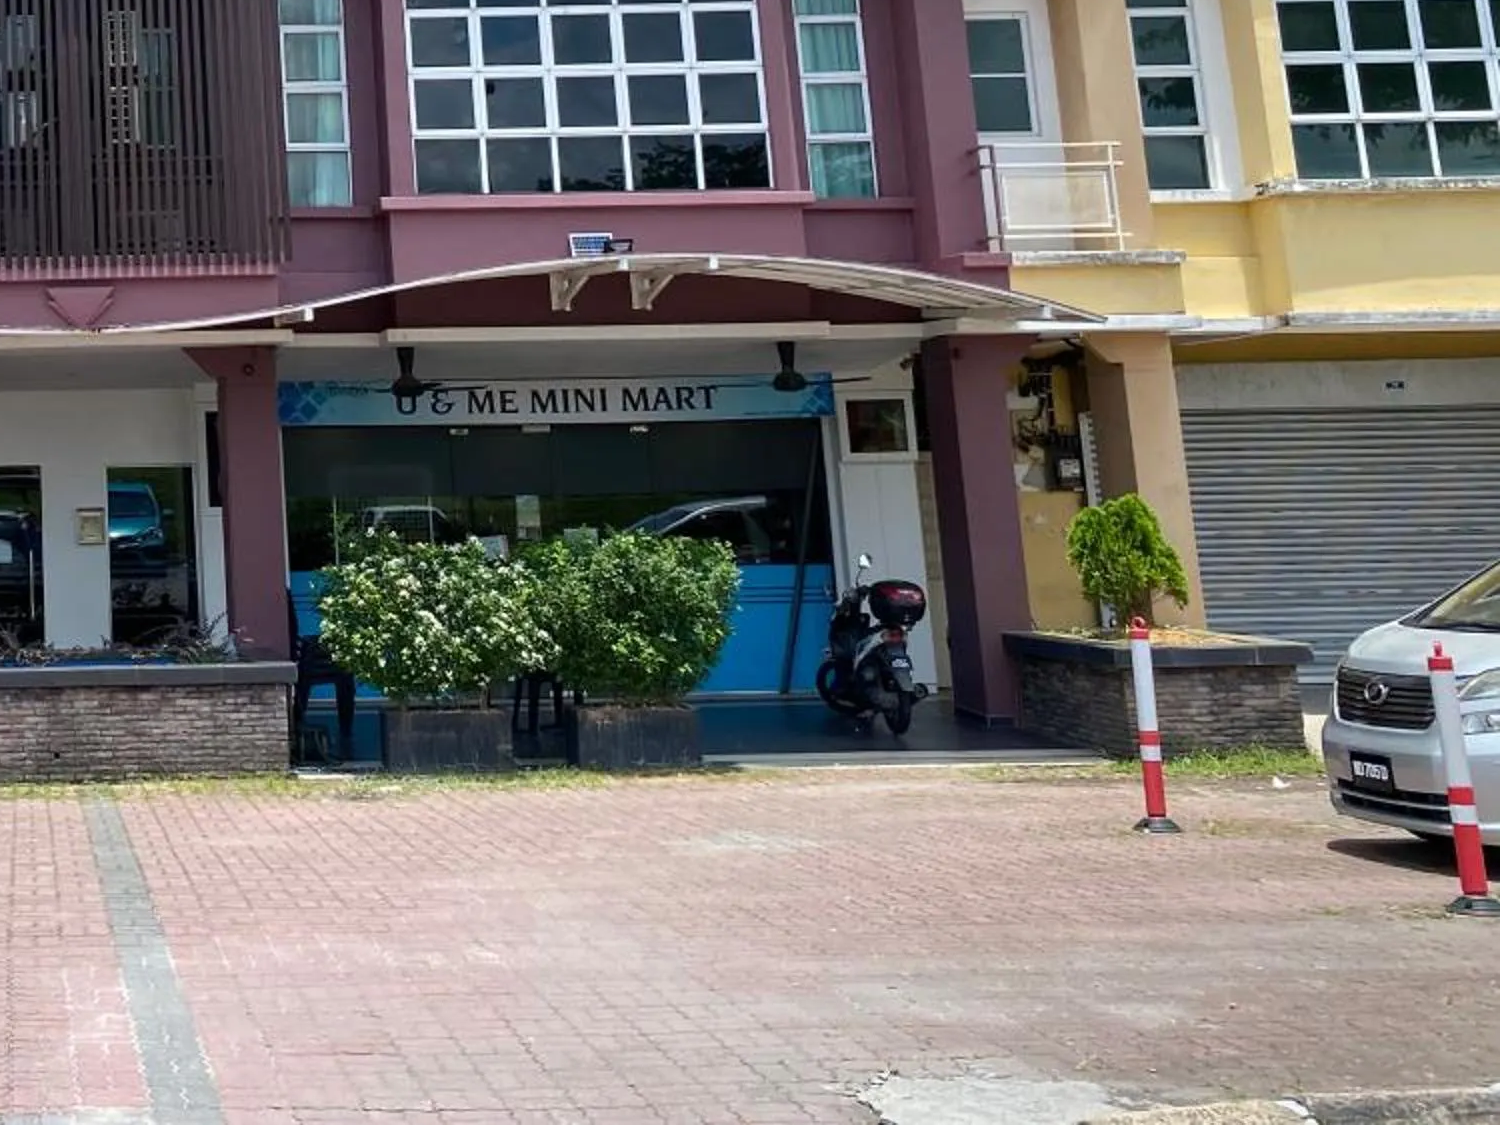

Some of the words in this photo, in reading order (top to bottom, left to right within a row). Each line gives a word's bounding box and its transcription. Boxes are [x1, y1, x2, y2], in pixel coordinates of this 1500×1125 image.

[430, 389, 452, 415] &
[467, 389, 519, 415] ME
[530, 387, 608, 414] MINI
[621, 385, 718, 412] MART
